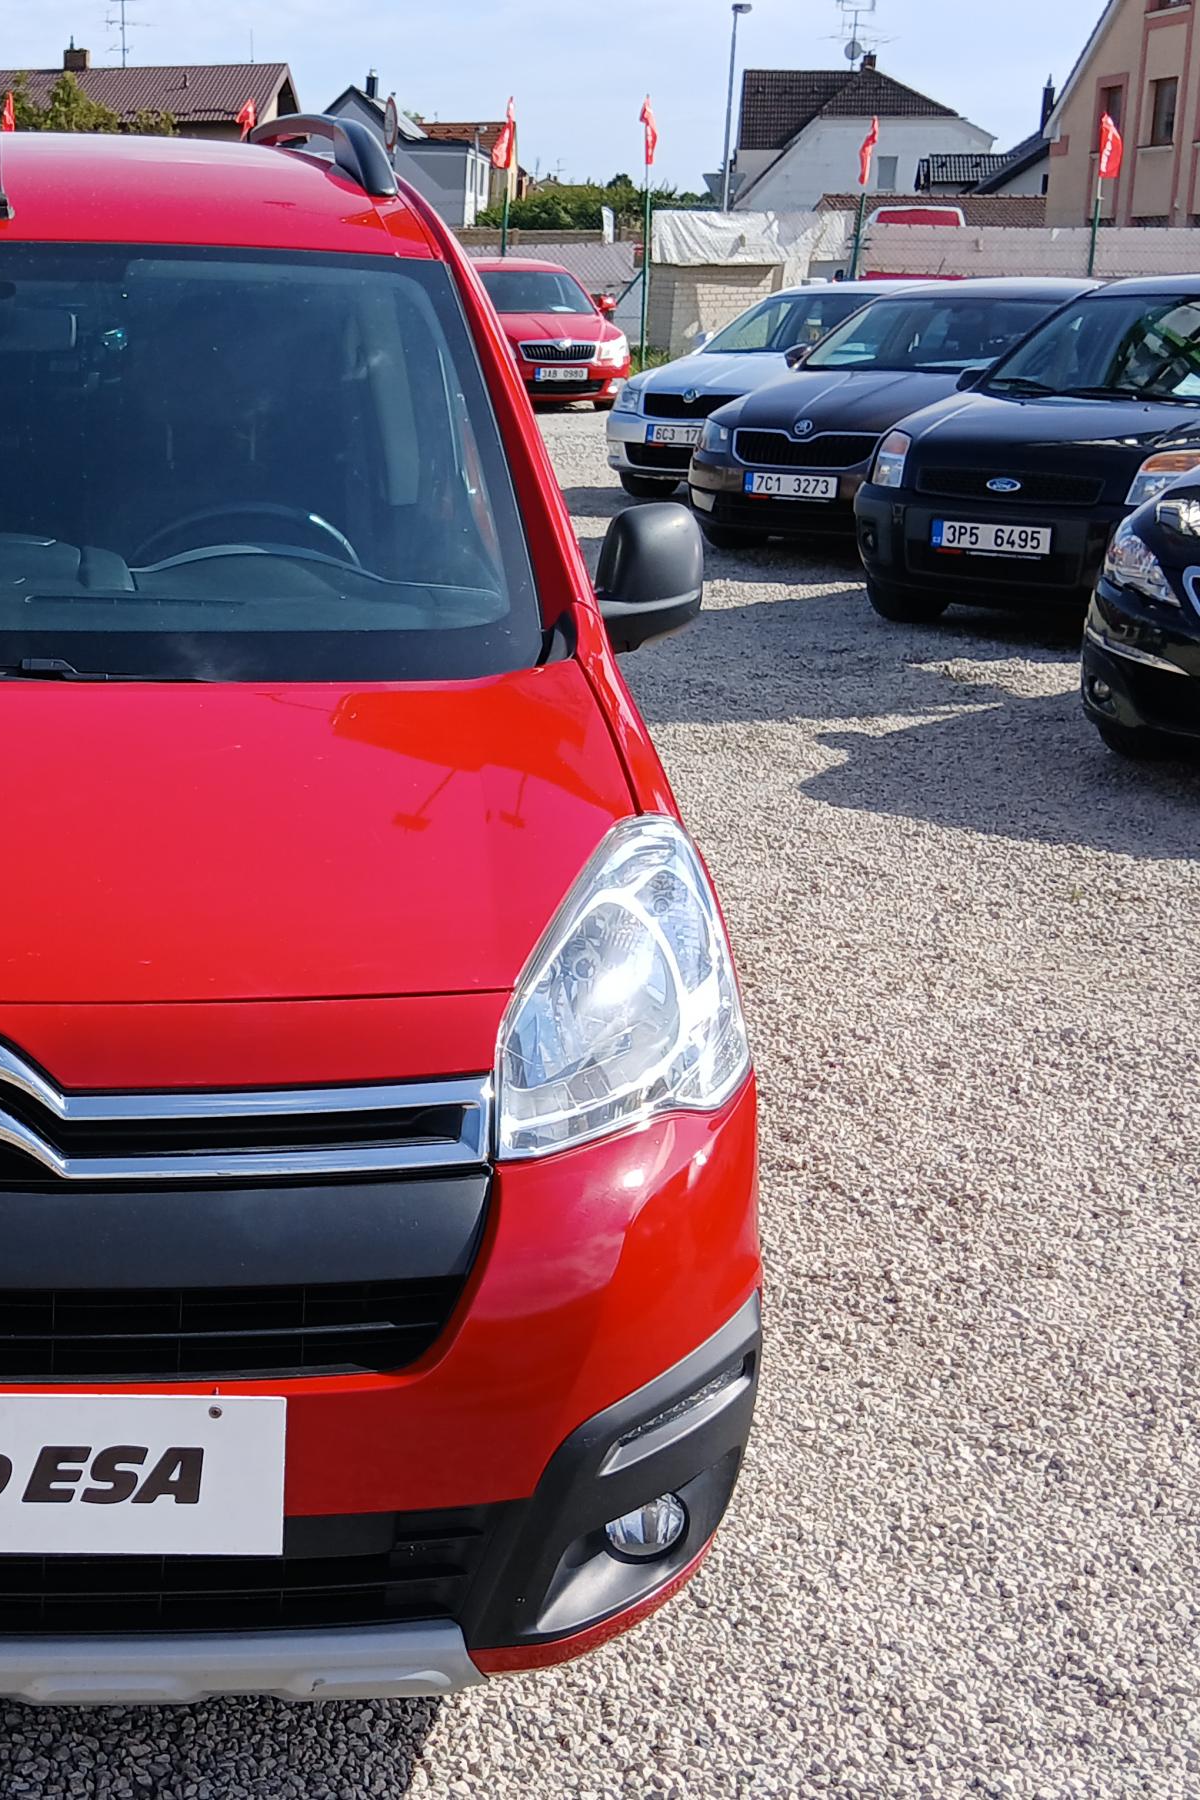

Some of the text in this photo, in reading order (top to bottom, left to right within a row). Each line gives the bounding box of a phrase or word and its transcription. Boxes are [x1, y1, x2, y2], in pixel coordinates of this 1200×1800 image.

[655, 428, 703, 442] 6C3 17
[756, 475, 830, 495] 7C1 3273
[946, 524, 1042, 550] 3P5 6495
[21, 1445, 204, 1504] ESA
